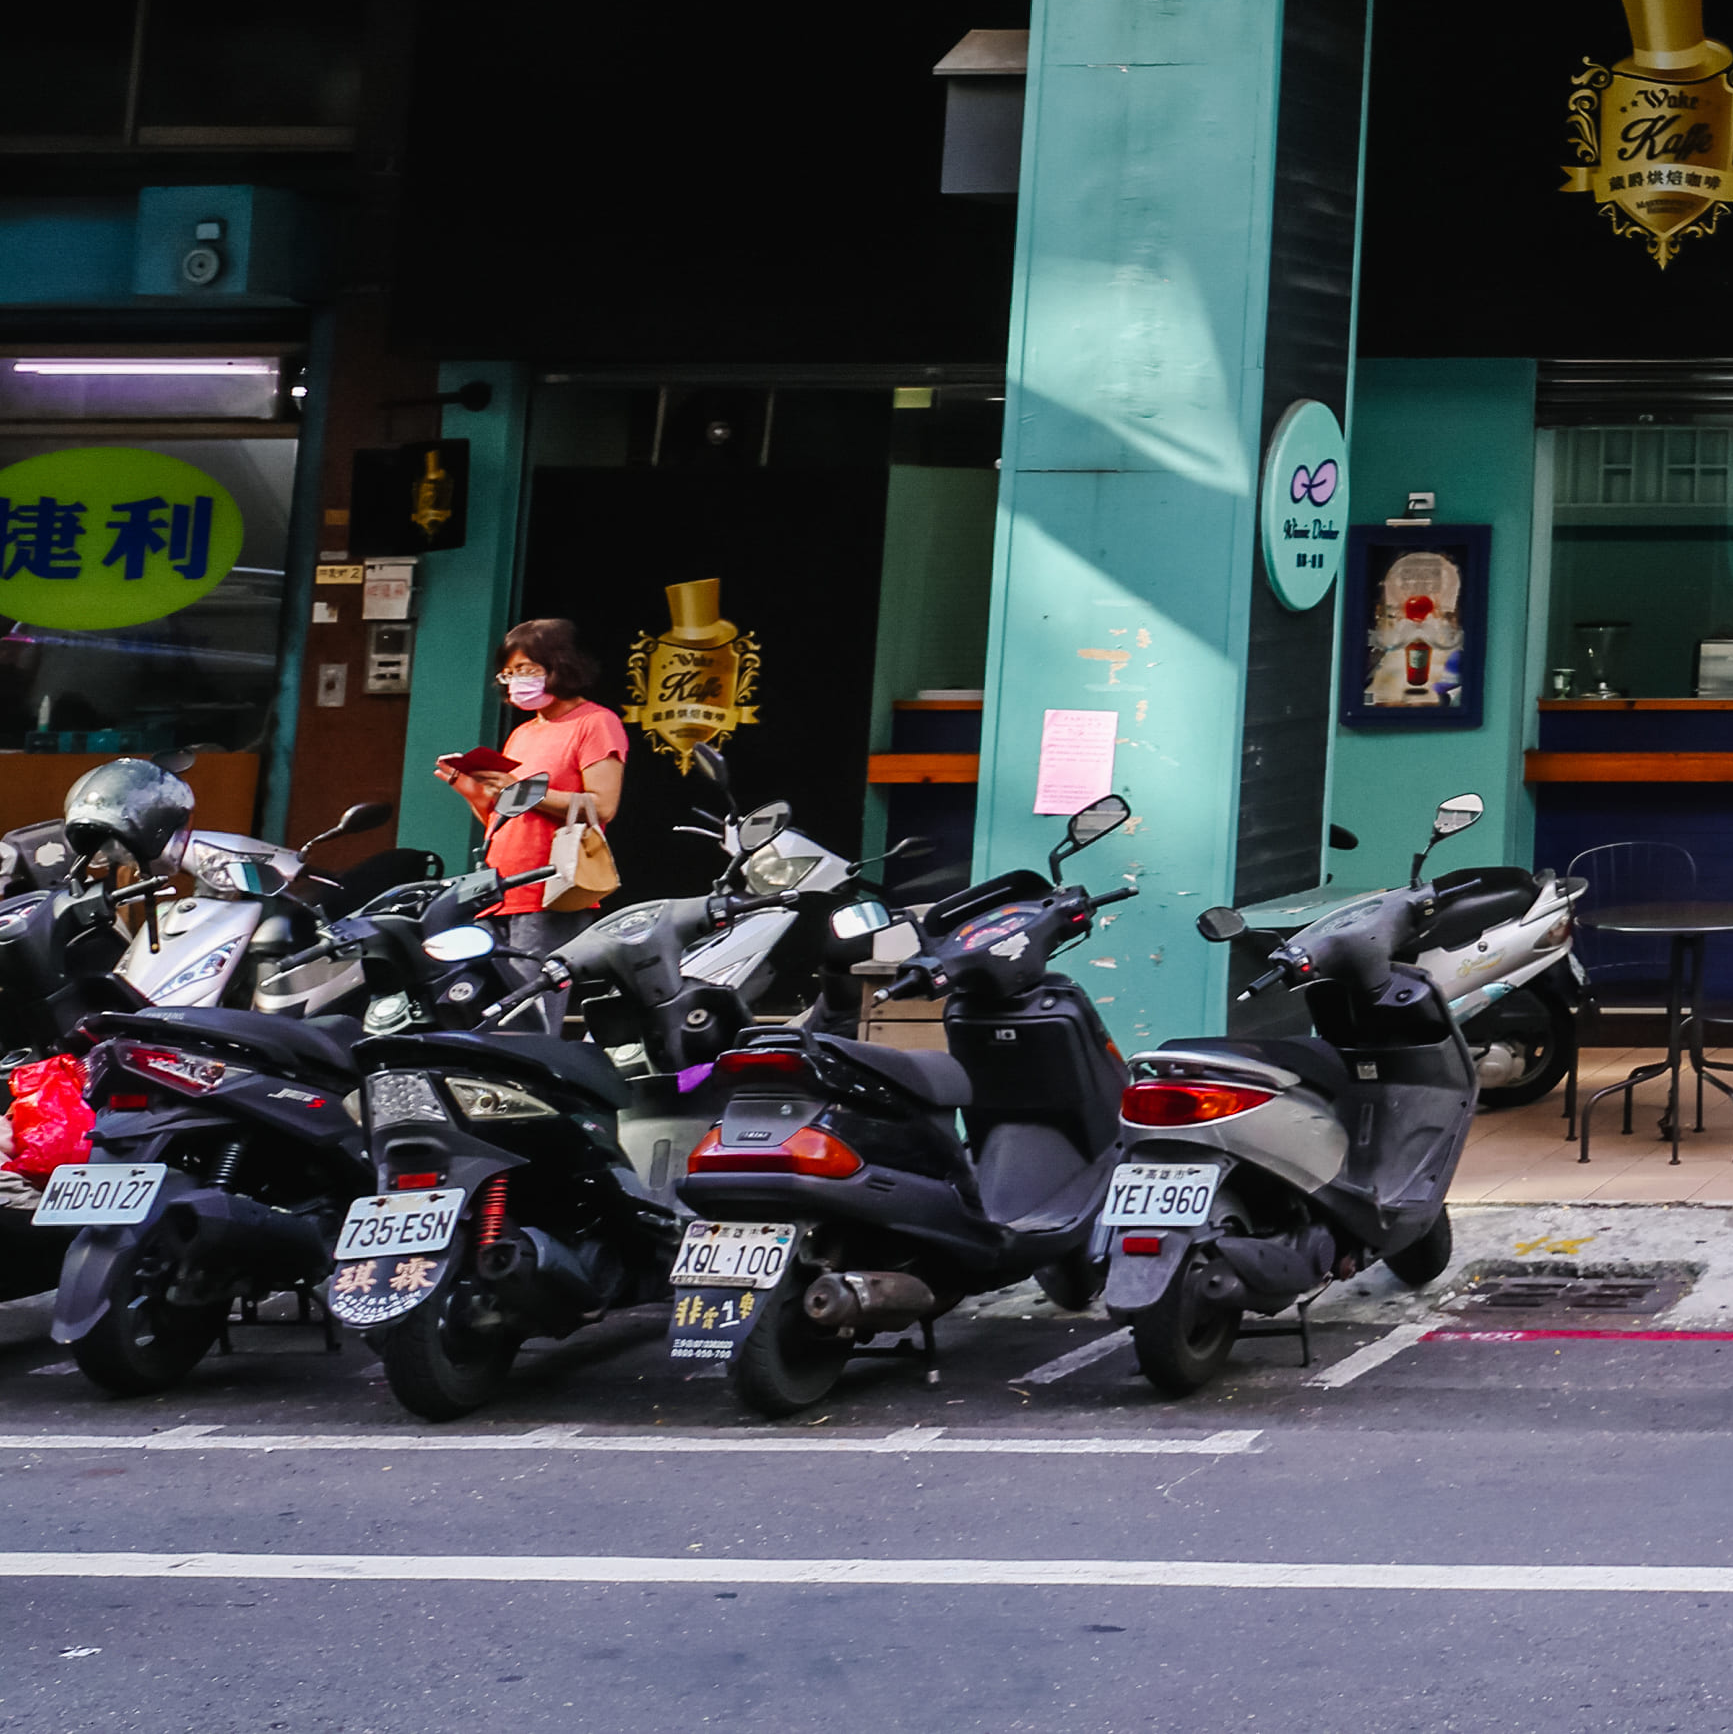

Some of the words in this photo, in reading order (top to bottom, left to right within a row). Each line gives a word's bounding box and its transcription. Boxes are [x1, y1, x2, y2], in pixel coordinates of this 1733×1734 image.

[1636, 88, 1699, 110] Wake
[1617, 114, 1713, 161] Kaffe
[0, 496, 214, 581] 捷利
